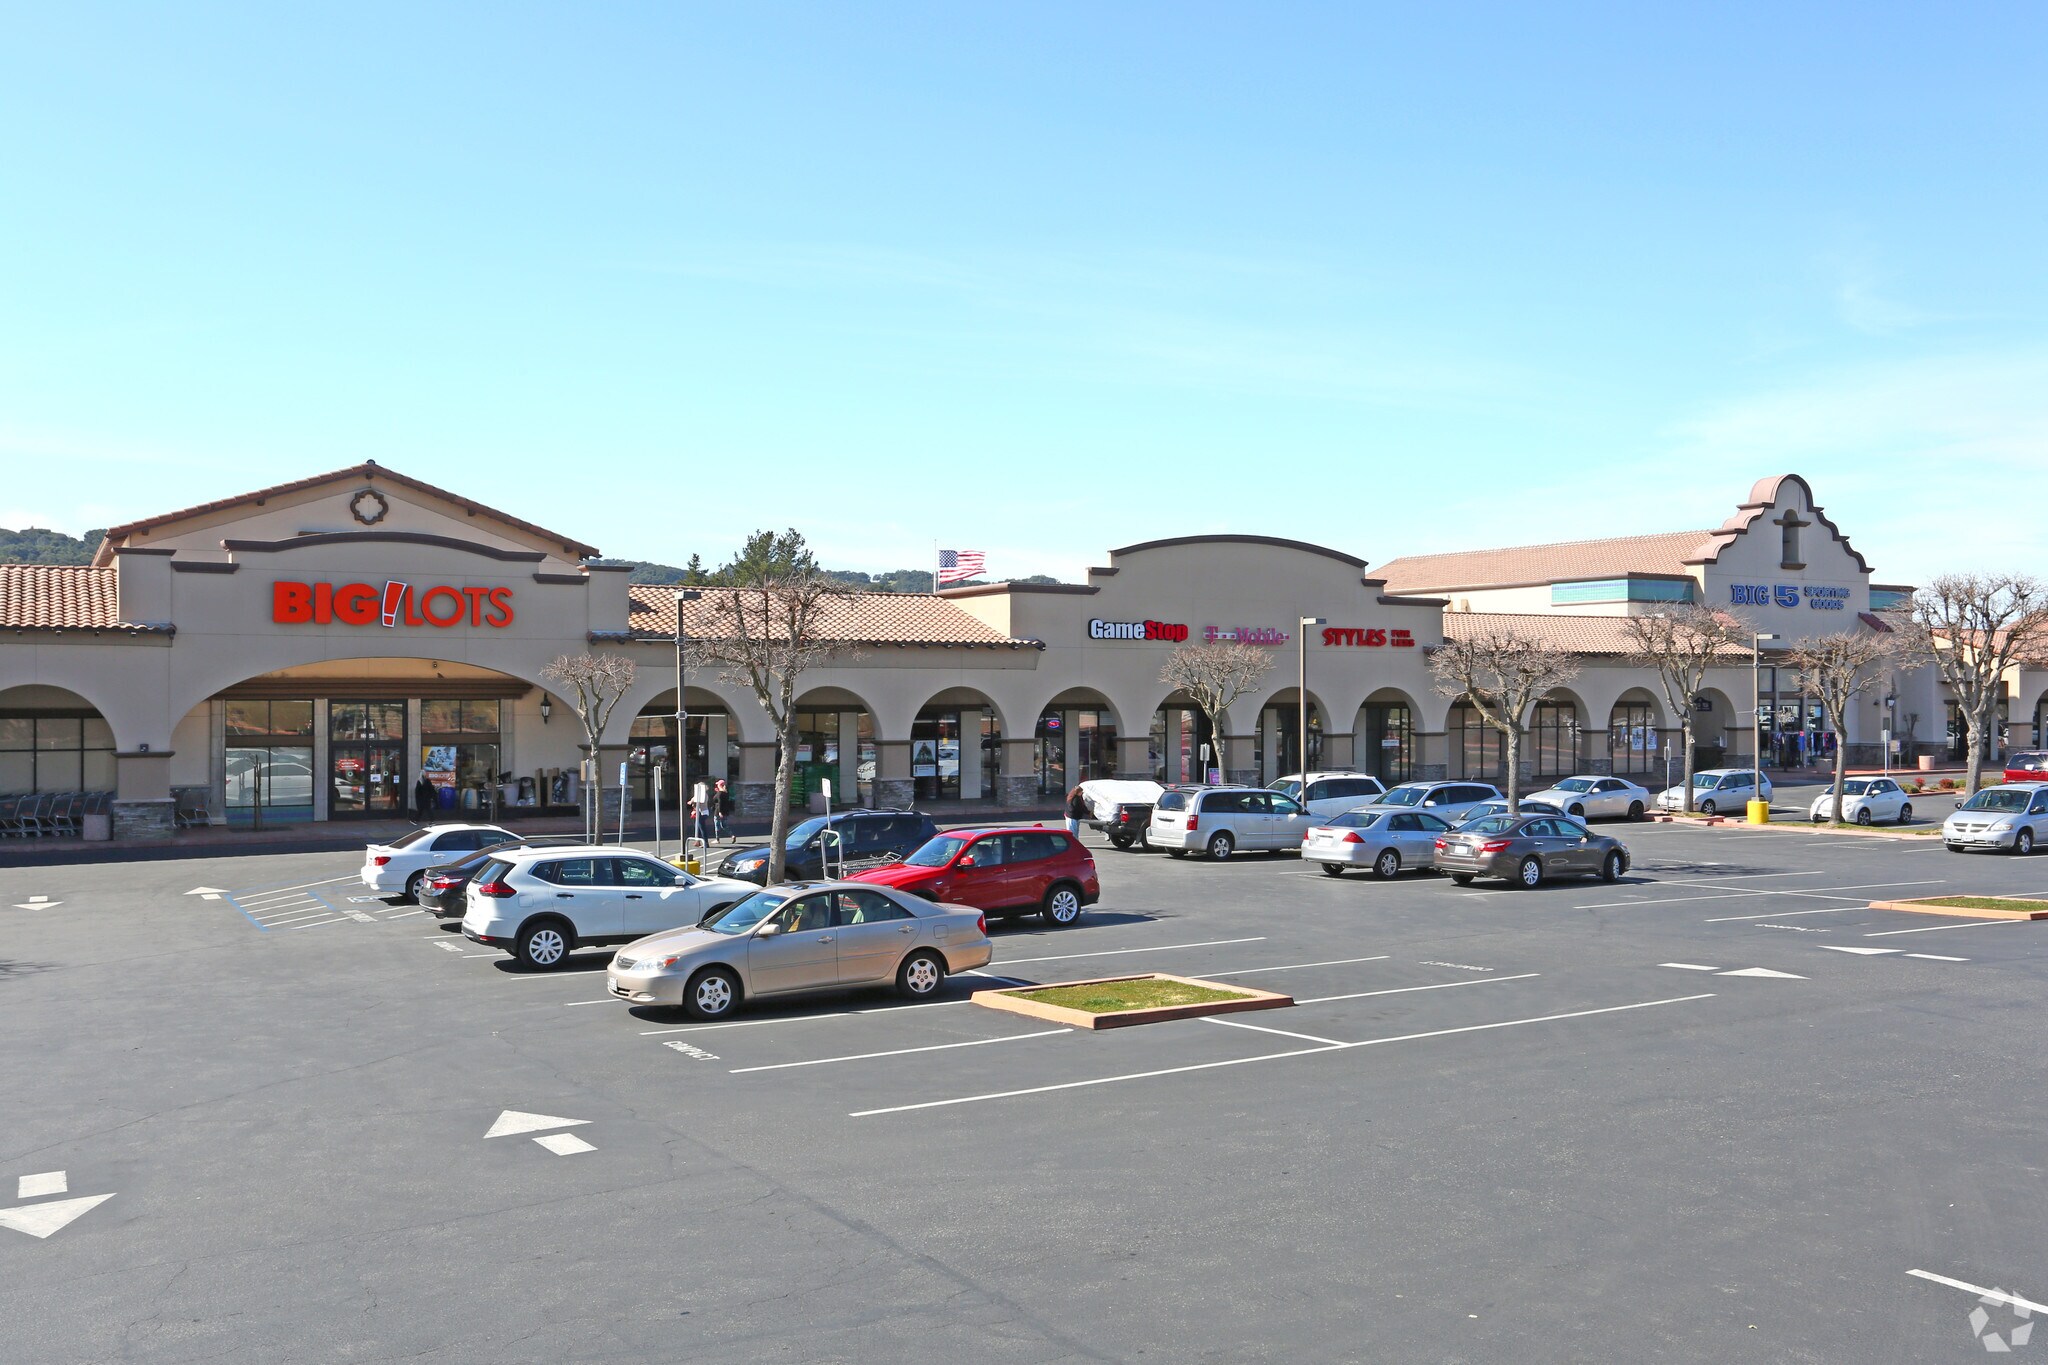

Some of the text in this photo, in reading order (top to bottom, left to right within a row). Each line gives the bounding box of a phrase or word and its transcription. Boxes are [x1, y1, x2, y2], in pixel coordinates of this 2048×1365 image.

[1731, 584, 1800, 609] BIG 5
[1804, 585, 1851, 598] SPORTING
[1811, 598, 1845, 610] GOODS
[1089, 619, 1188, 642] GameStop
[1322, 627, 1387, 647] STYLES
